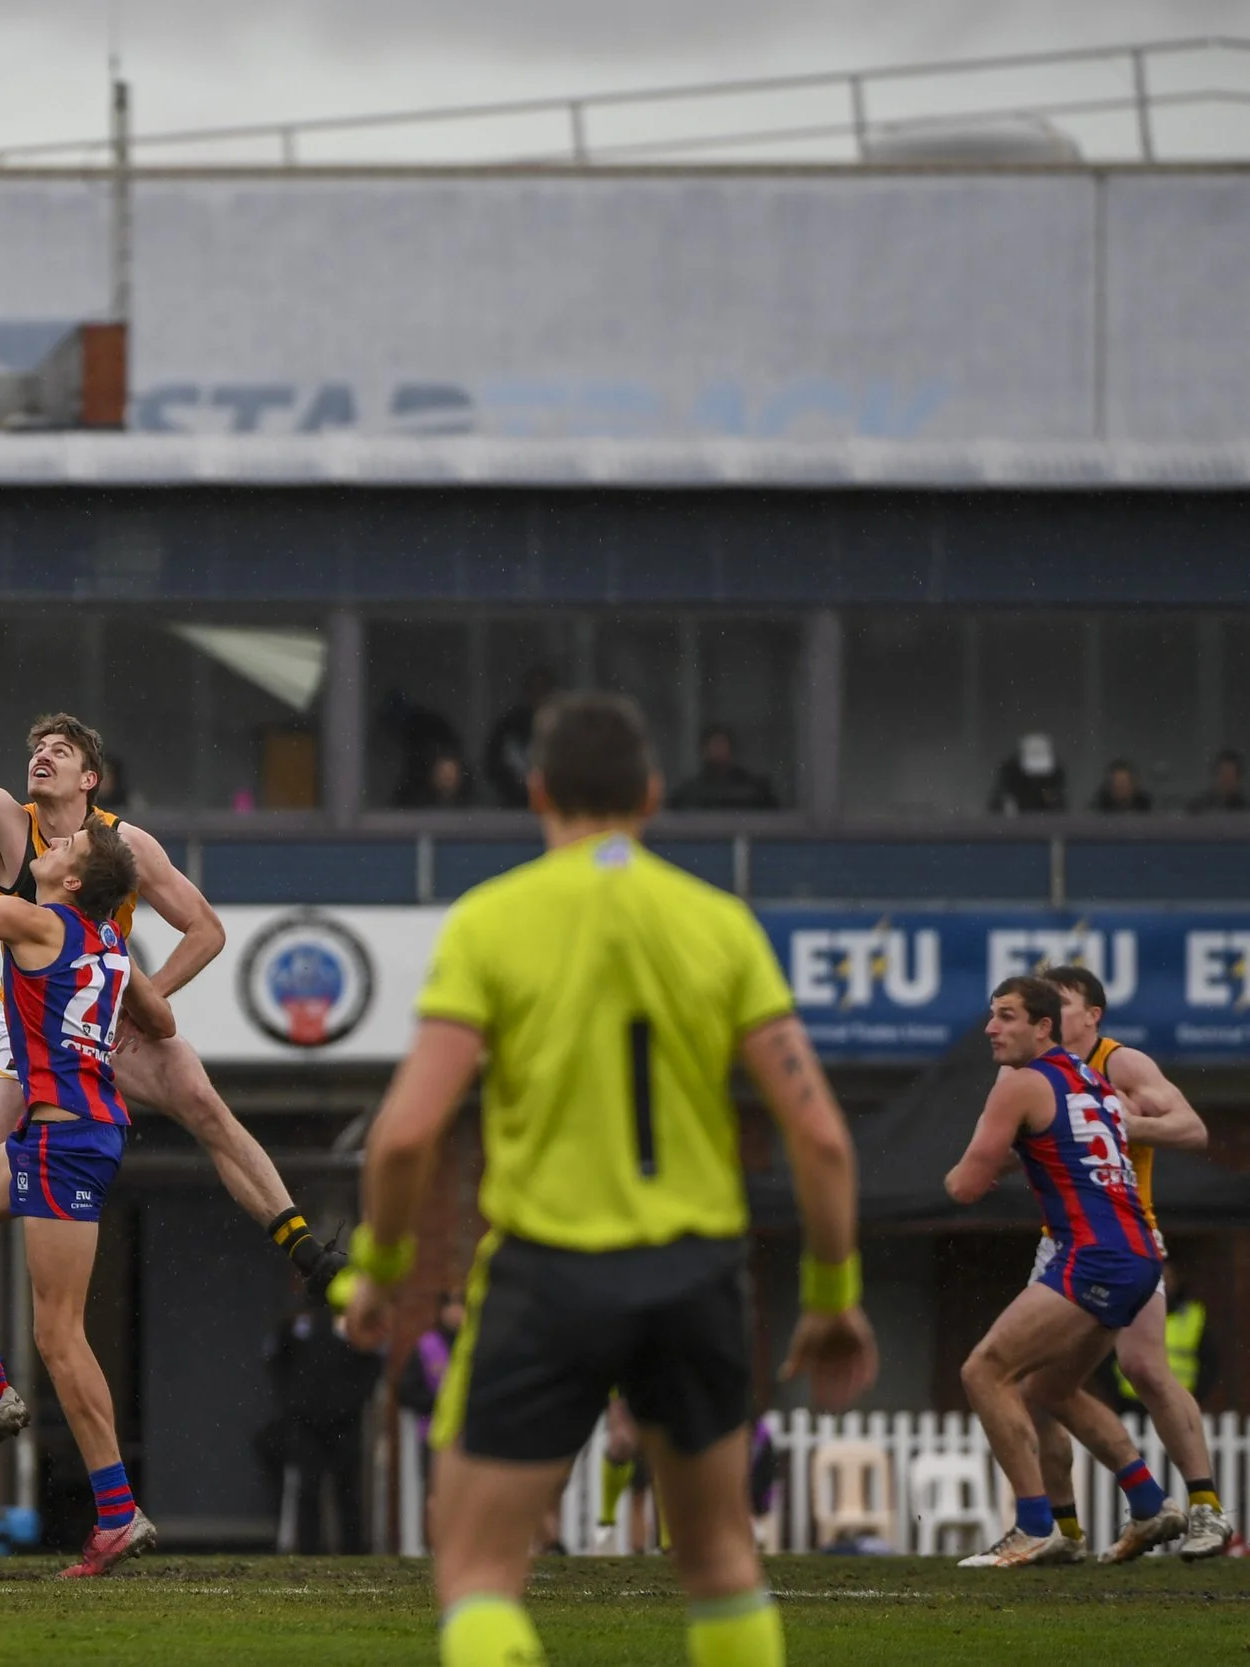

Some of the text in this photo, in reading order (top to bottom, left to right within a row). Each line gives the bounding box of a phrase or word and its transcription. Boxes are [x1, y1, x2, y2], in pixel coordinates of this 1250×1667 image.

[61, 953, 131, 1047] 27
[790, 929, 940, 1007] ETU
[627, 1010, 658, 1181] 1
